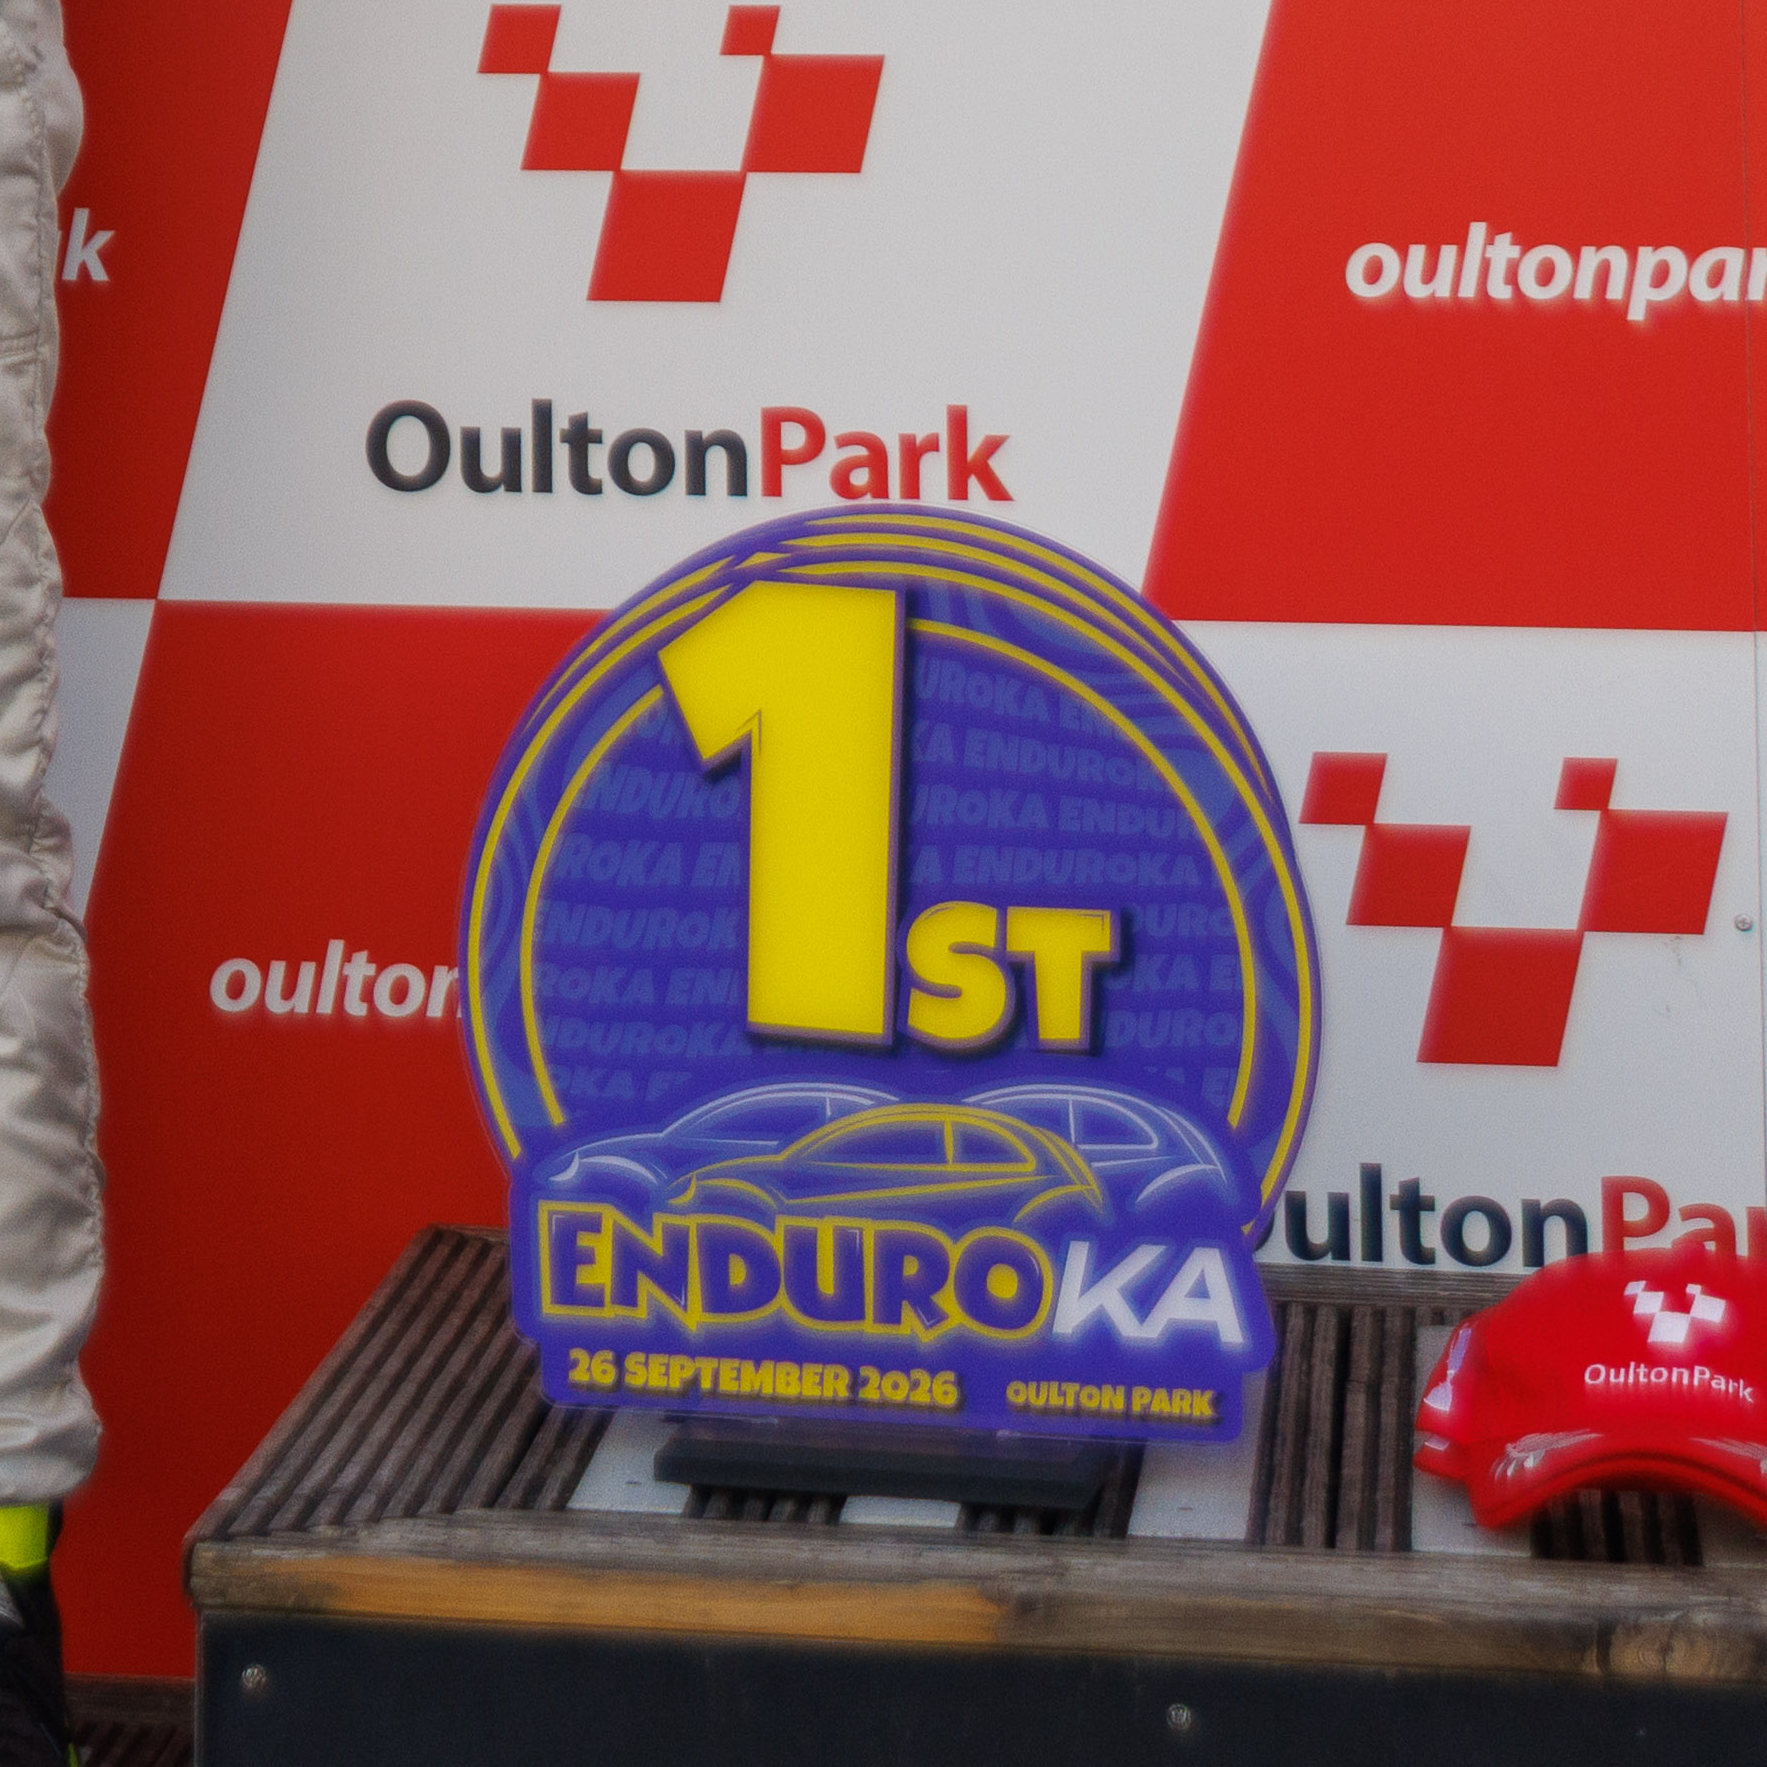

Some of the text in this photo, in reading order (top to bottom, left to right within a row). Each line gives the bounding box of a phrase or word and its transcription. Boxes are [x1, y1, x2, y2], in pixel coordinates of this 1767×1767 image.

[365, 403, 1013, 501] OultonPark
[657, 577, 1114, 1042] 1ST
[538, 1199, 1245, 1343] ENDUROKA
[569, 1348, 960, 1406] 26 SEPTEMBER 2026
[1005, 1378, 1216, 1418] OULTON PARK
[1584, 1360, 1755, 1403] OultonPark
